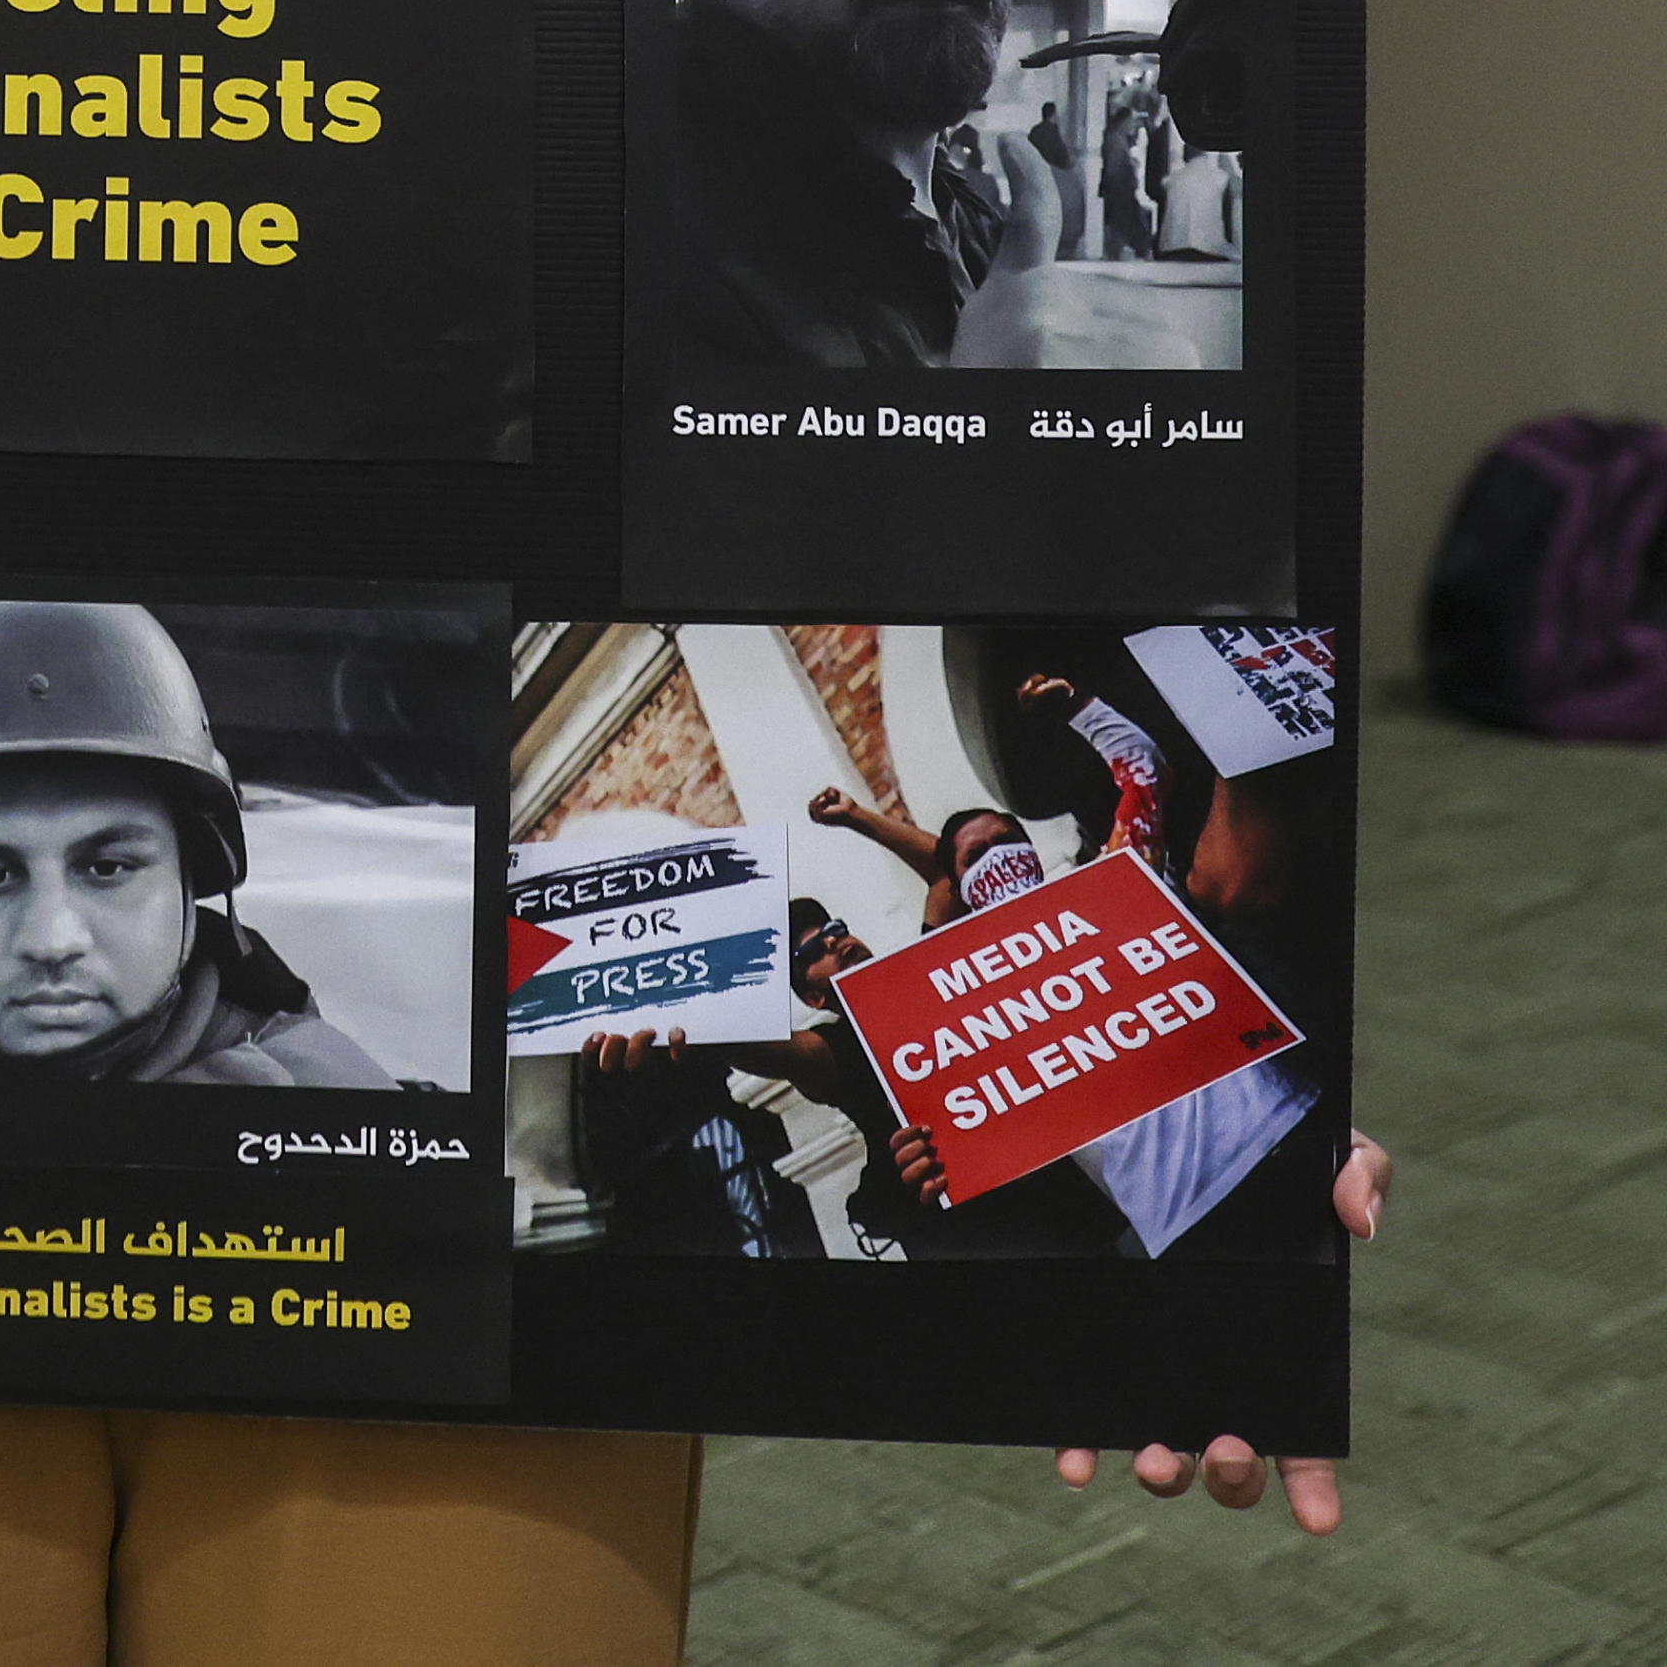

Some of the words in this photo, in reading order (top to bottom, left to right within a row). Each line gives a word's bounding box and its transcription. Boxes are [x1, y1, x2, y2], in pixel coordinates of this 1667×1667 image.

[672, 404, 788, 436] Samer
[797, 406, 865, 437] Abu
[877, 407, 986, 444] Daqqa
[1029, 410, 1095, 439] دقة
[1105, 402, 1153, 448] أبو
[1161, 410, 1244, 448] سامر
[515, 853, 716, 917] FREEDOM
[589, 907, 681, 946] FOR
[570, 948, 710, 1005] PRESS
[928, 910, 1101, 1003] MEDIA
[892, 955, 1112, 1083] CANNOT
[1117, 921, 1200, 976] BE
[943, 980, 1216, 1131] SILENCED
[237, 1126, 377, 1164] الدحدوح
[388, 1128, 470, 1167] حمزة
[123, 1220, 346, 1262] استهداف
[173, 1285, 214, 1323] is
[229, 1296, 255, 1325] a
[271, 1288, 412, 1330] Crime
